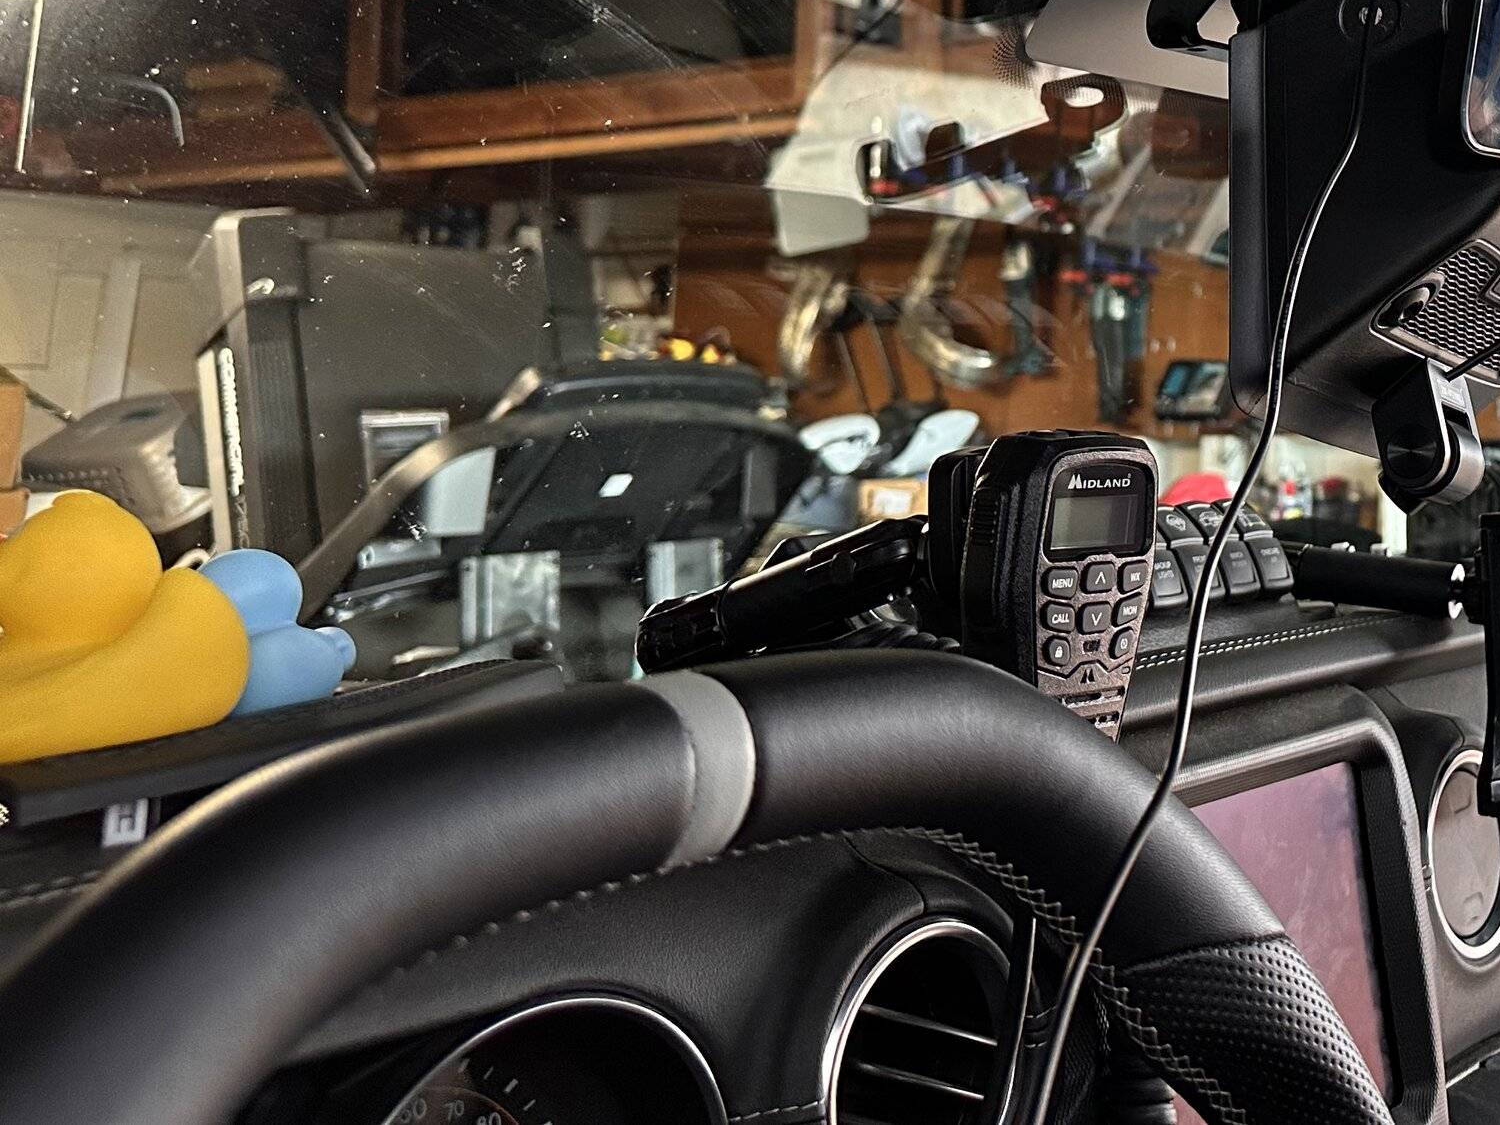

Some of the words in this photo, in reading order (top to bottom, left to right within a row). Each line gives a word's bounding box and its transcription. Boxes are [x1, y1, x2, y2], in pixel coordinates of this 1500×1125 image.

[1068, 473, 1131, 490] MIDLAND
[1052, 577, 1074, 589] MENU
[1122, 605, 1138, 616] MON
[1051, 613, 1070, 624] CALL
[444, 1099, 465, 1121] 70
